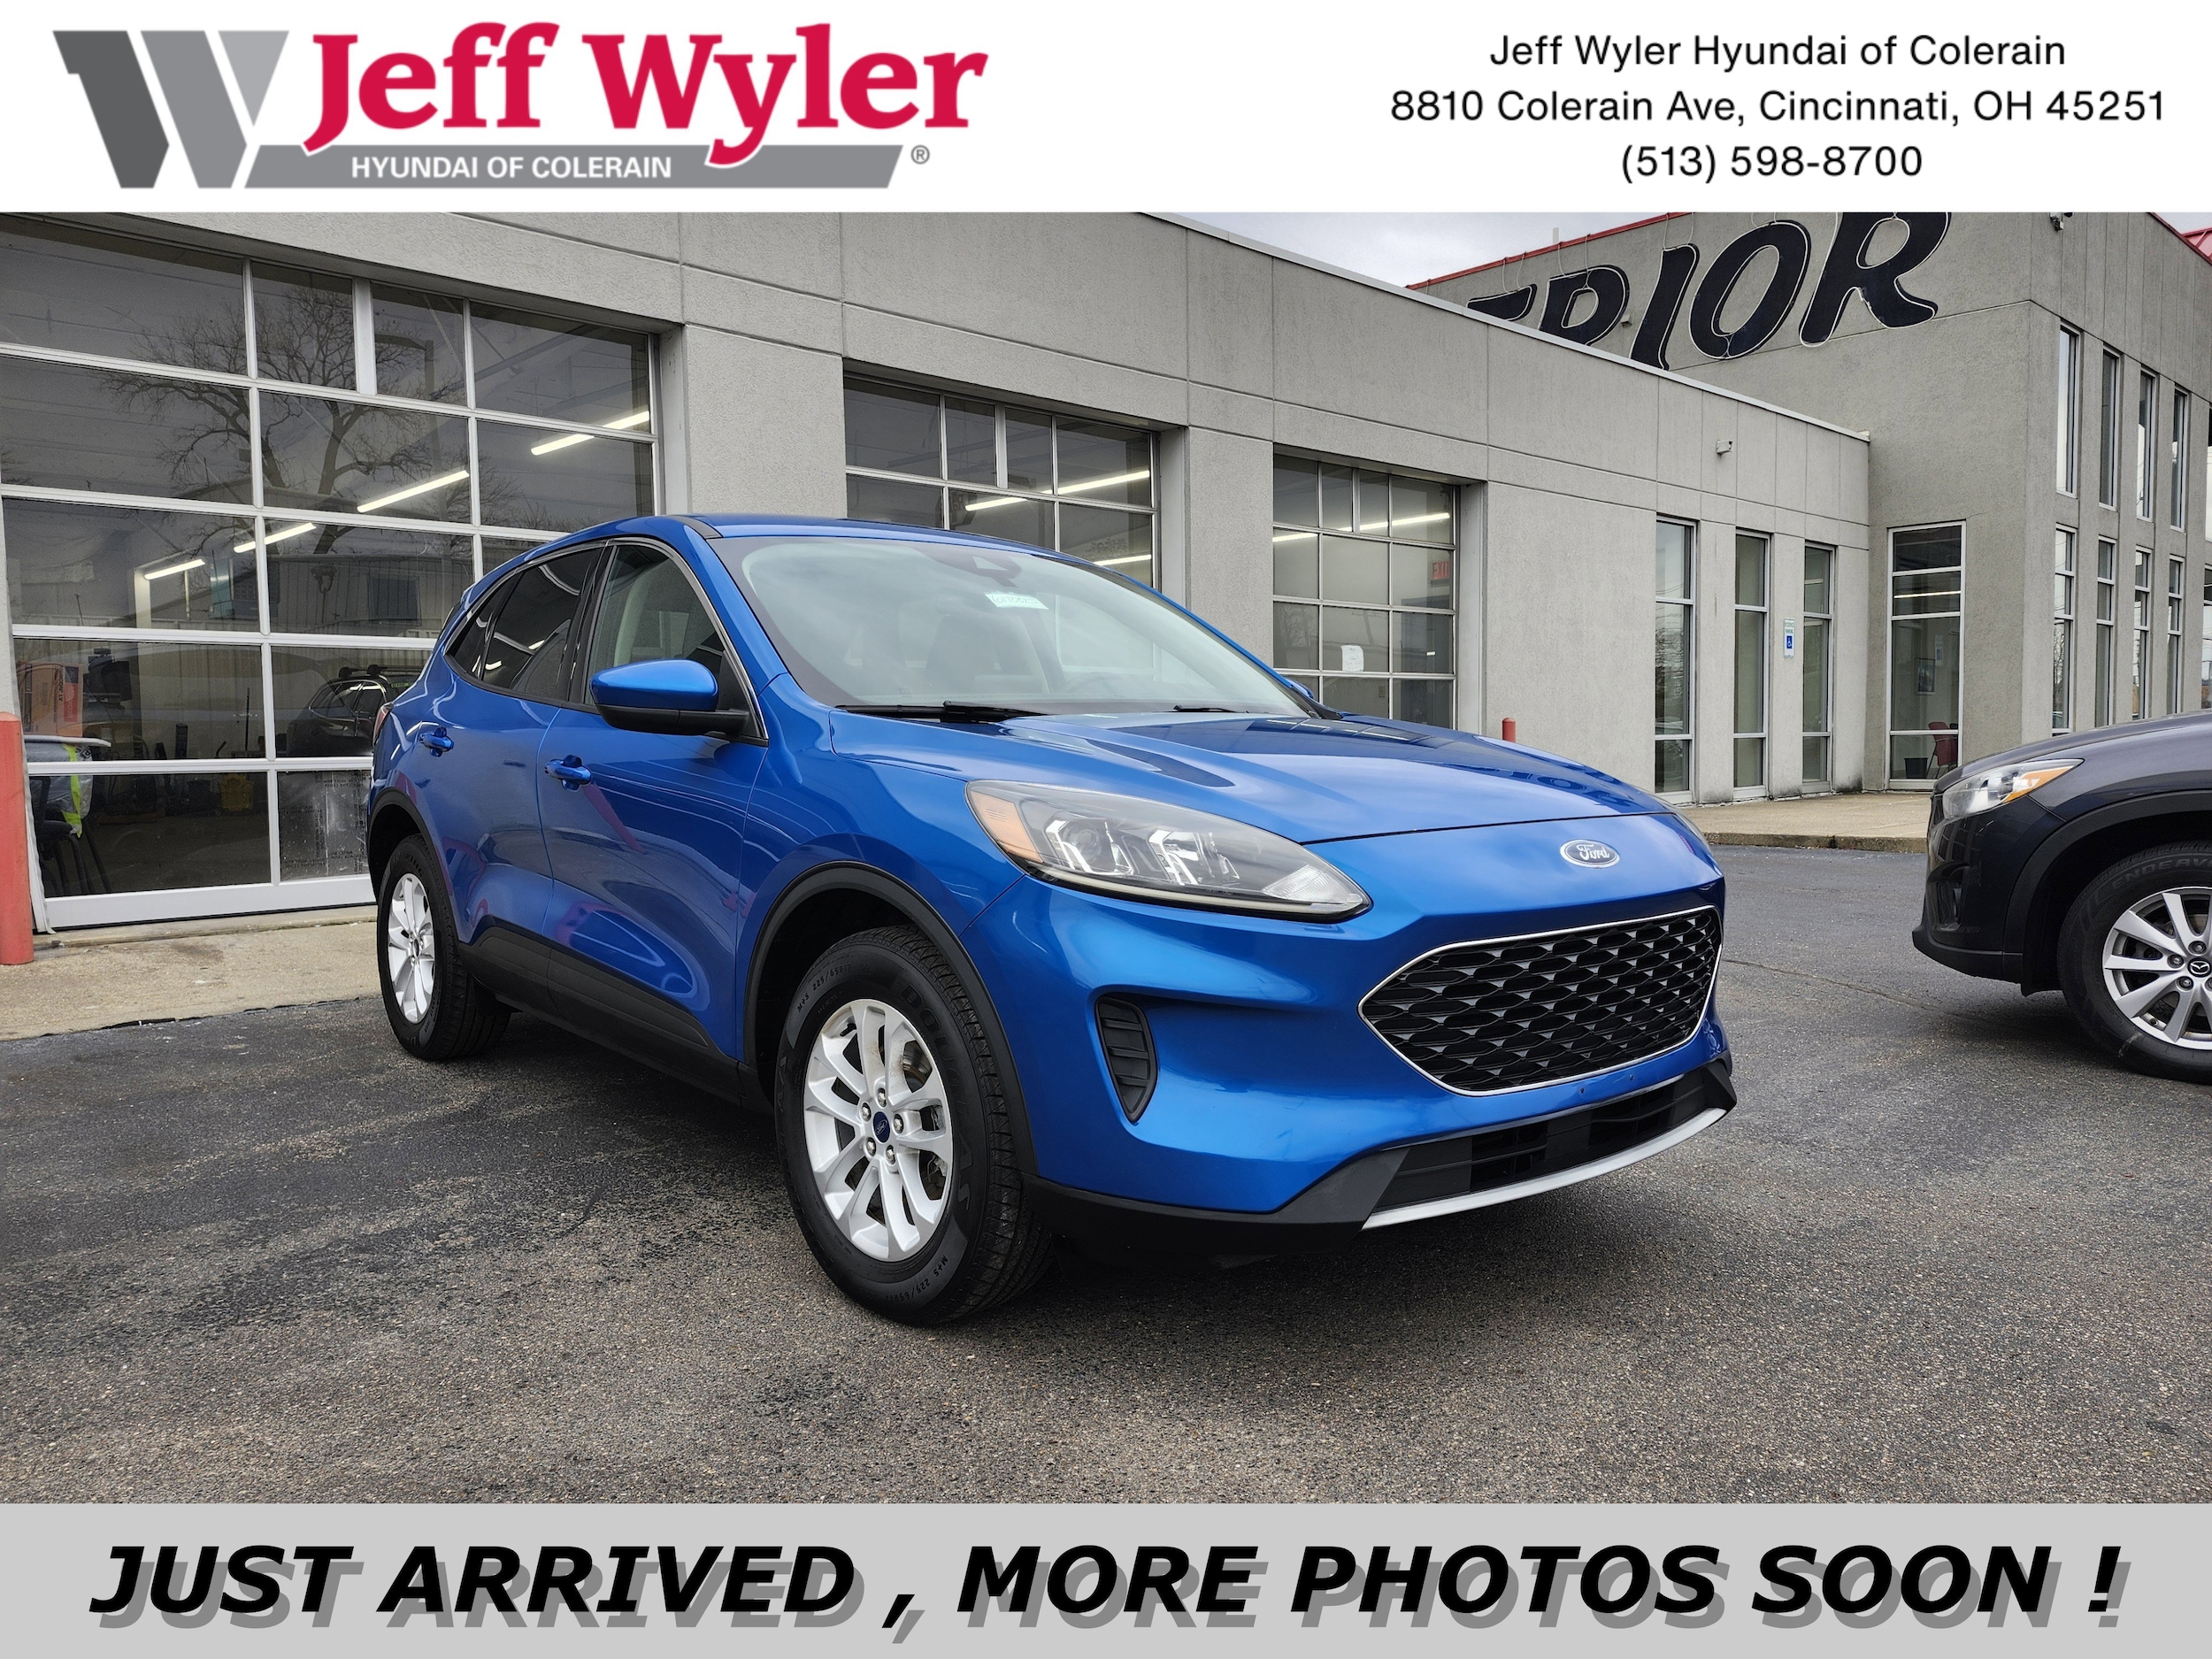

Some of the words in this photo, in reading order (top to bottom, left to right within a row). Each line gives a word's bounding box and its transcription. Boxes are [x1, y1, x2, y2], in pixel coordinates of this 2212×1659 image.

[1432, 561, 1450, 580] EXIT
[2111, 857, 2212, 890] ENDEAV
[811, 962, 853, 992] 225/65R17
[933, 1255, 949, 1277] M+S
